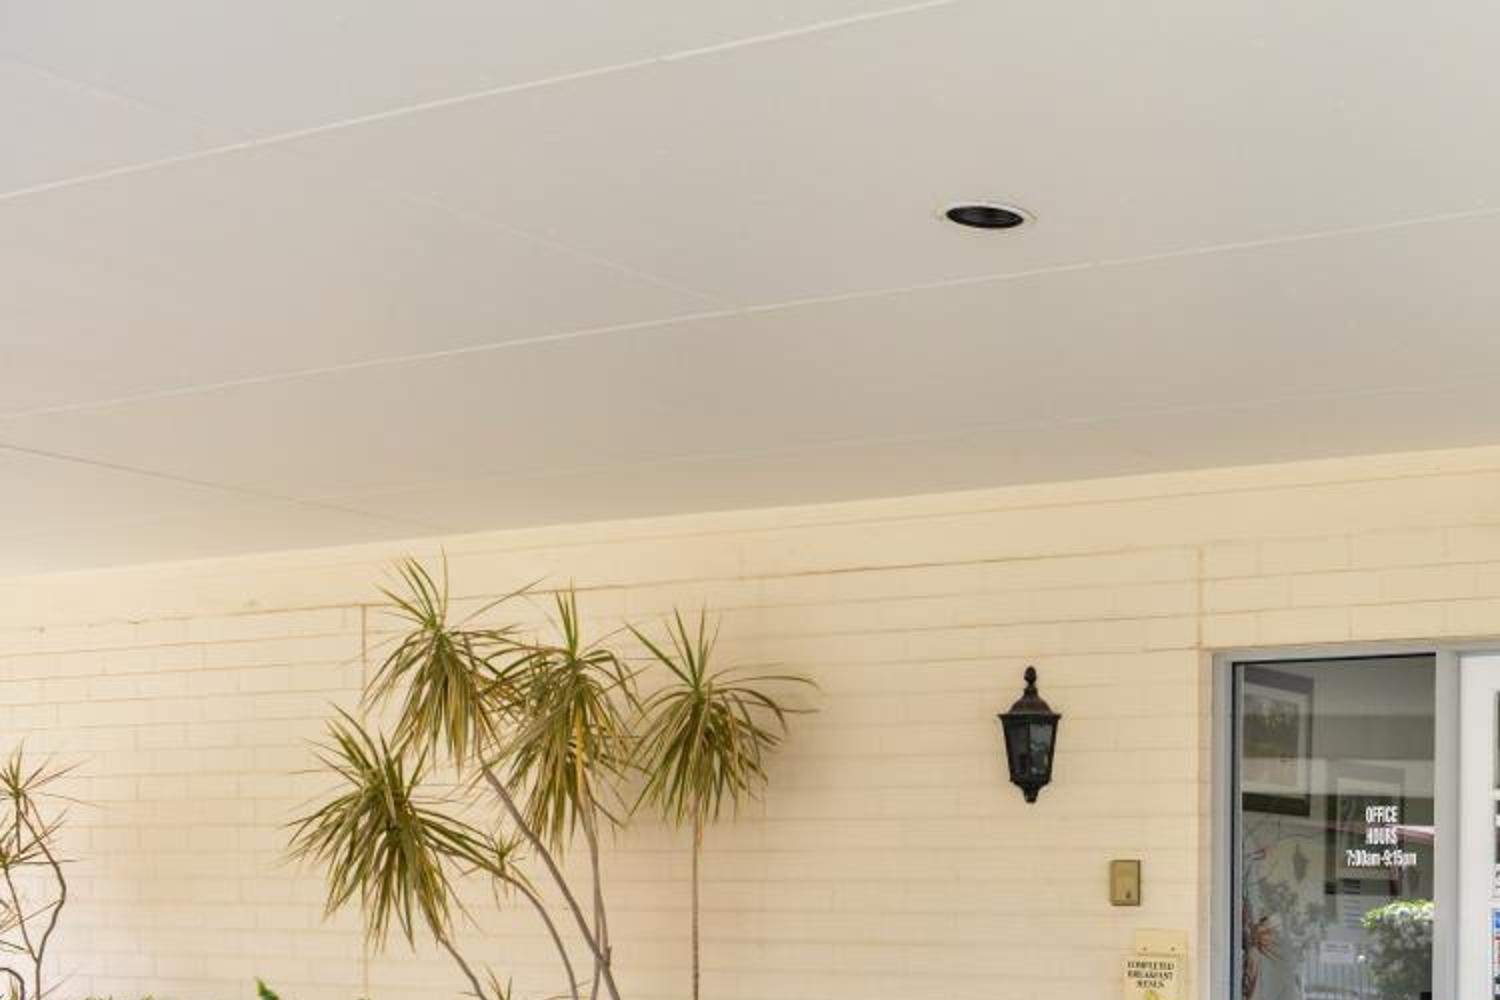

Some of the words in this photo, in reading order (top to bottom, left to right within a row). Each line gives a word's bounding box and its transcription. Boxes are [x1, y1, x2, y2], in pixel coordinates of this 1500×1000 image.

[1365, 805, 1398, 823] OFFICE
[1365, 827, 1398, 845] HOURS
[1127, 970, 1173, 981] BREAKFAST
